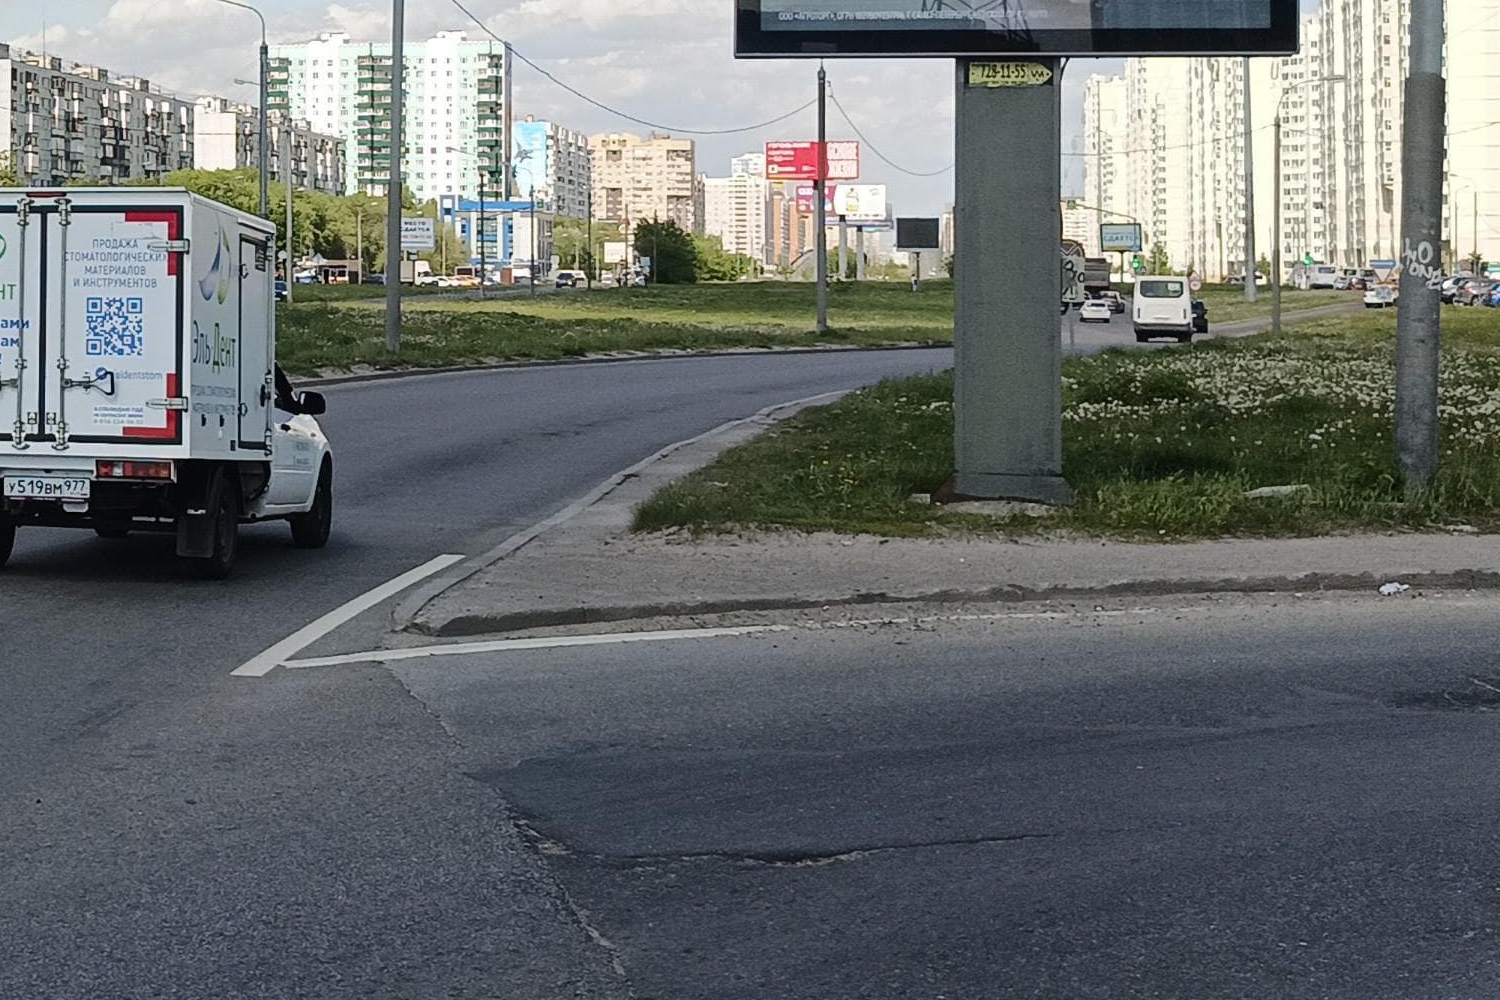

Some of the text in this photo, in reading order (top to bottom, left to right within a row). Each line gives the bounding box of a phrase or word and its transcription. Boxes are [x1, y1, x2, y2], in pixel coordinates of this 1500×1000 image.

[92, 239, 139, 250] ПРОДАЖА
[63, 251, 167, 262] СТОМАТОЛОГИЧЕСКИХ
[84, 265, 147, 276] МАТЕРИАЛОВ
[73, 278, 158, 289] И ИНСТРУМЕНТОВ
